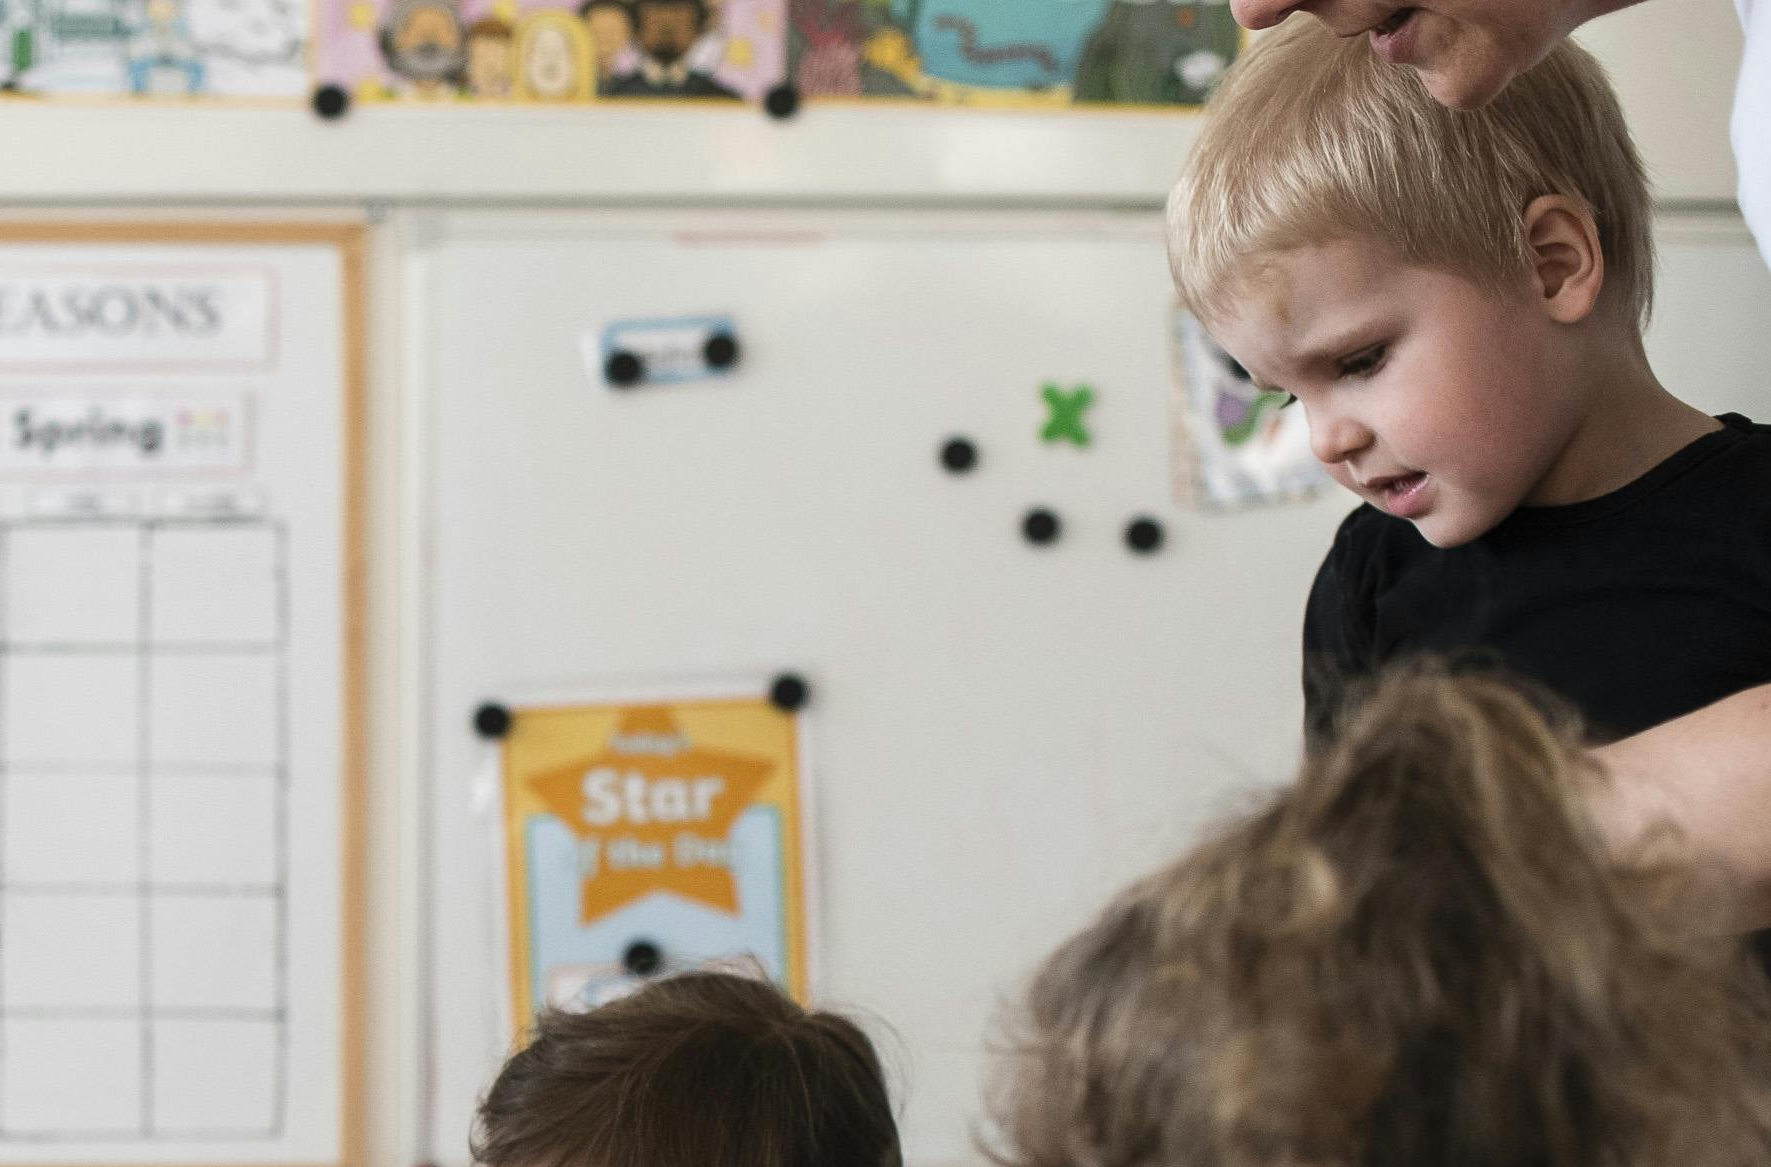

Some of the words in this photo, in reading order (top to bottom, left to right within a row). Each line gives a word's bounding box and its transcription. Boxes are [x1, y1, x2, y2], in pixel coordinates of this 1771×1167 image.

[13, 407, 165, 456] Spring
[582, 768, 725, 827] Star
[607, 838, 665, 870] the
